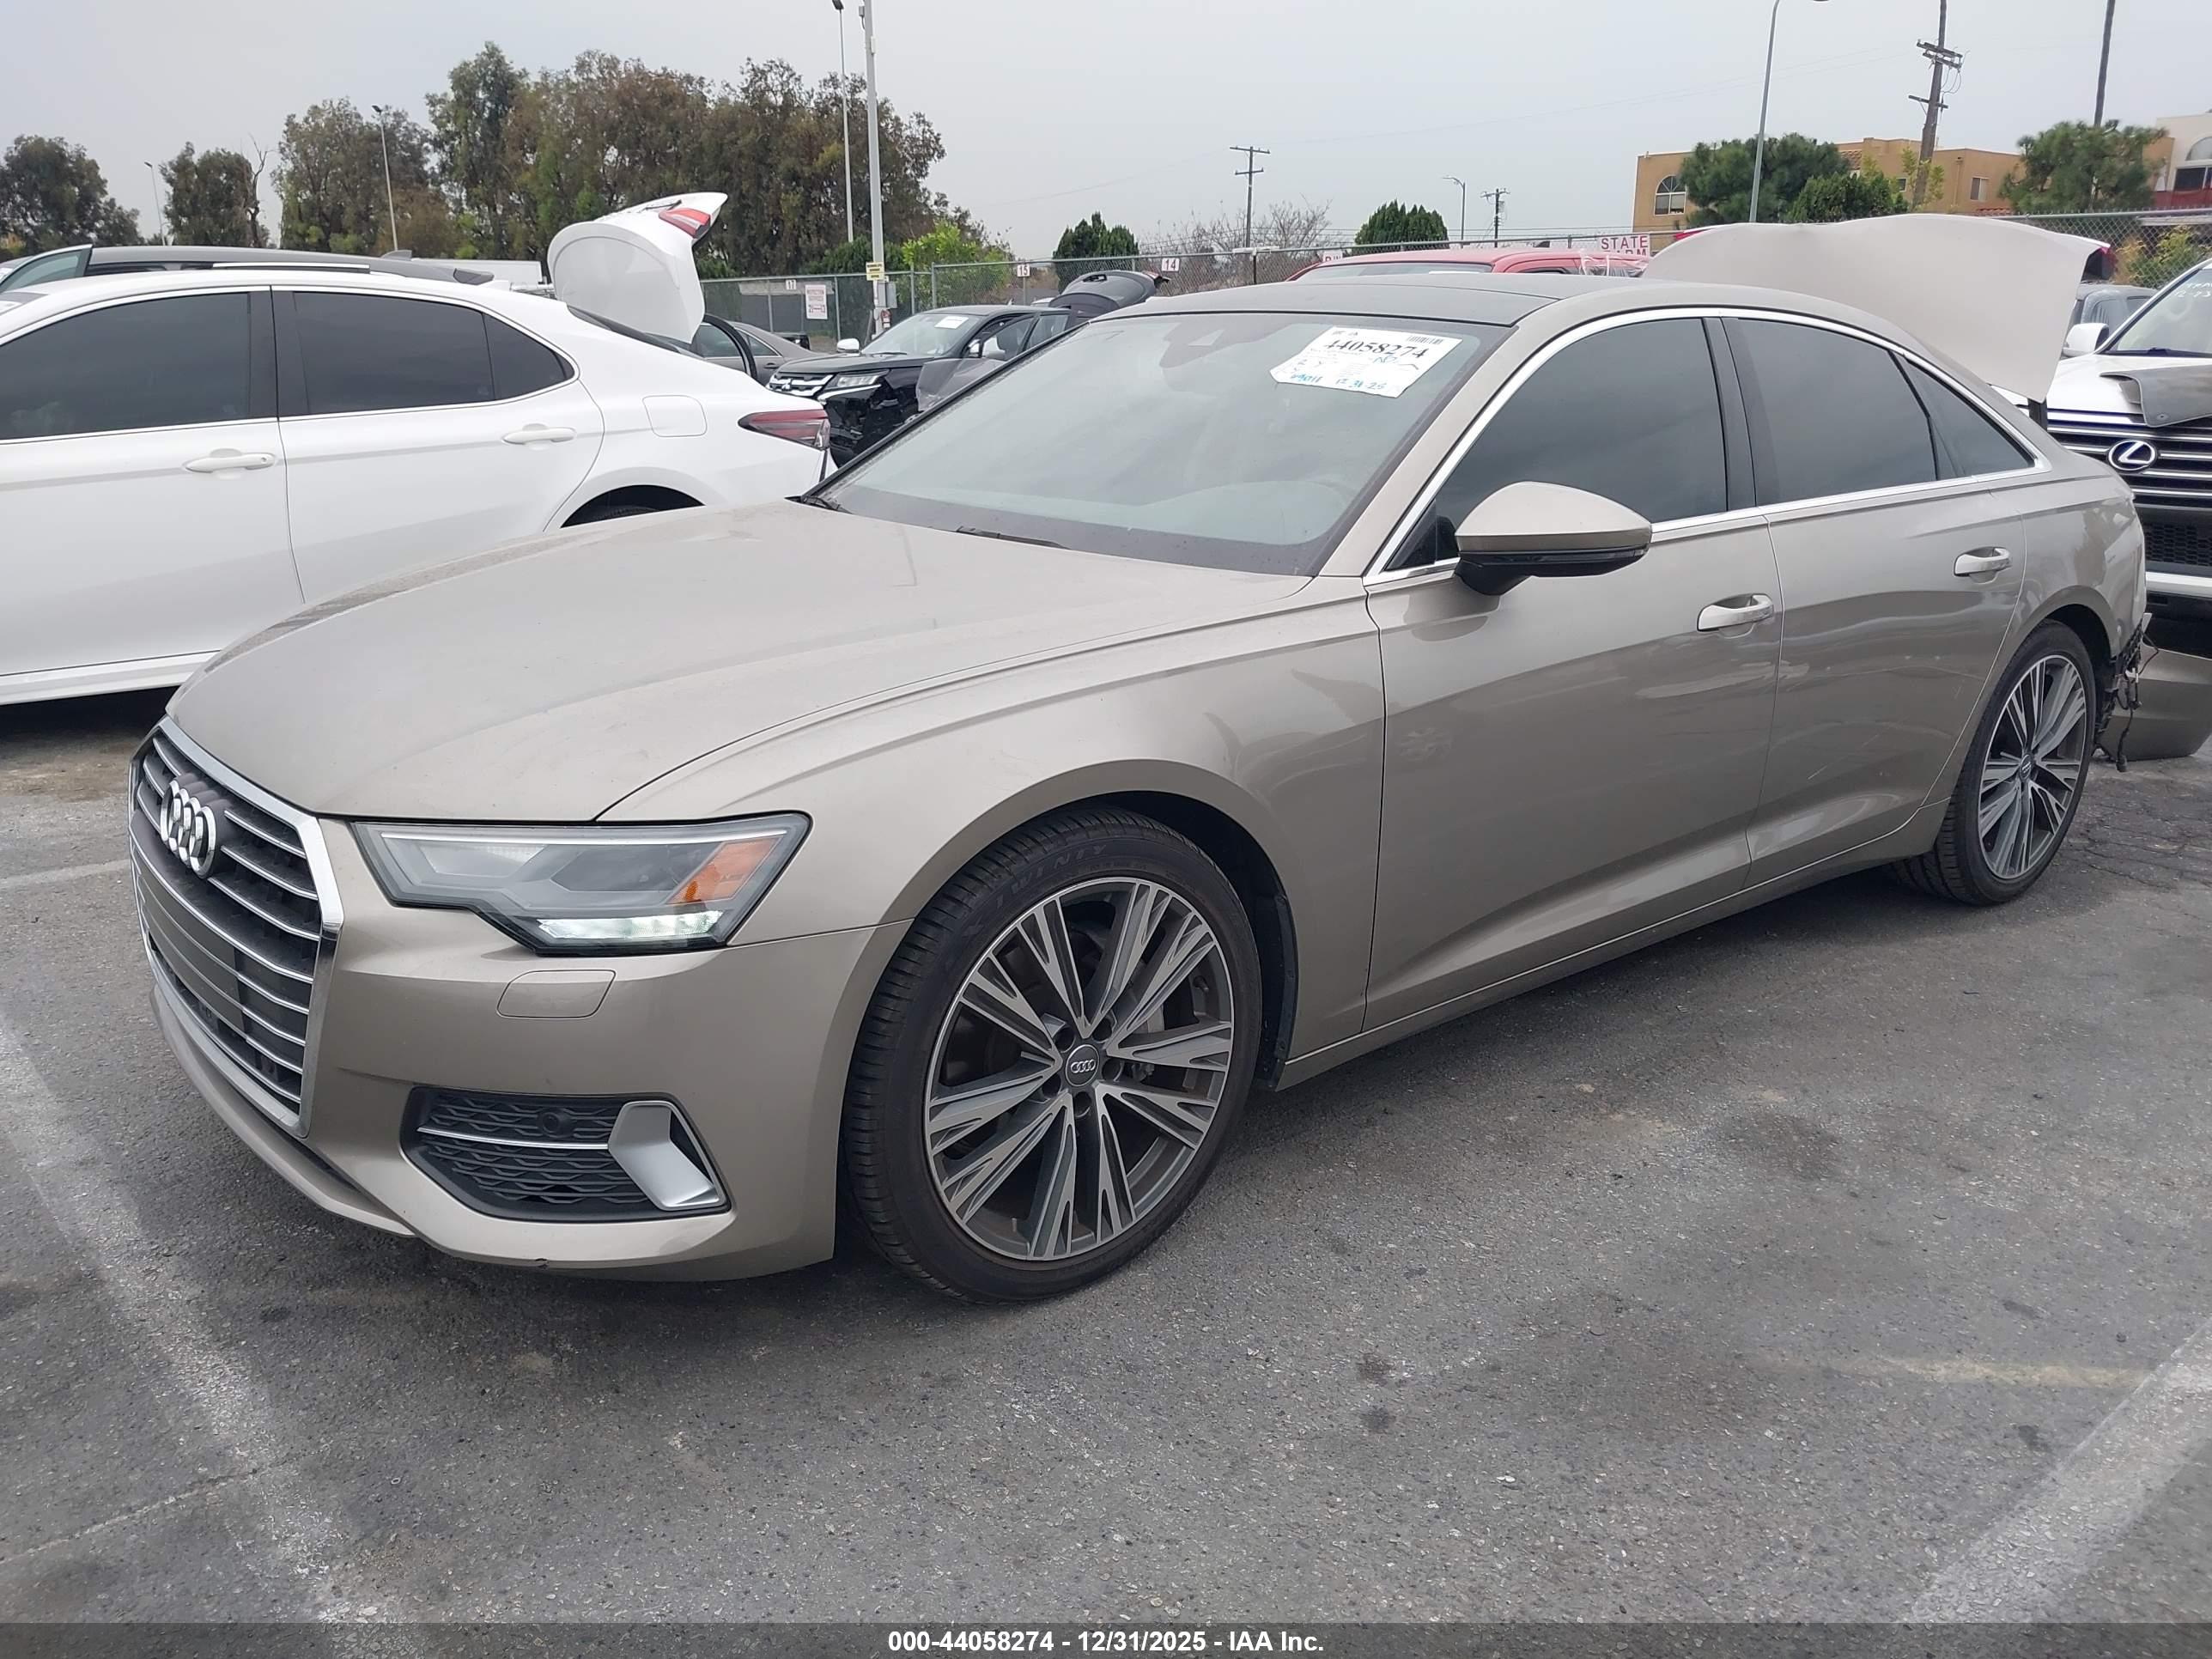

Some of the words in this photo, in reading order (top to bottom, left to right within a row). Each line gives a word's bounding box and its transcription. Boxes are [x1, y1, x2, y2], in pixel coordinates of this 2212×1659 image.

[1601, 235, 1649, 250] STATE
[1018, 264, 1029, 276] 15
[1165, 258, 1176, 270] 14
[1324, 339, 1429, 358] 44058274
